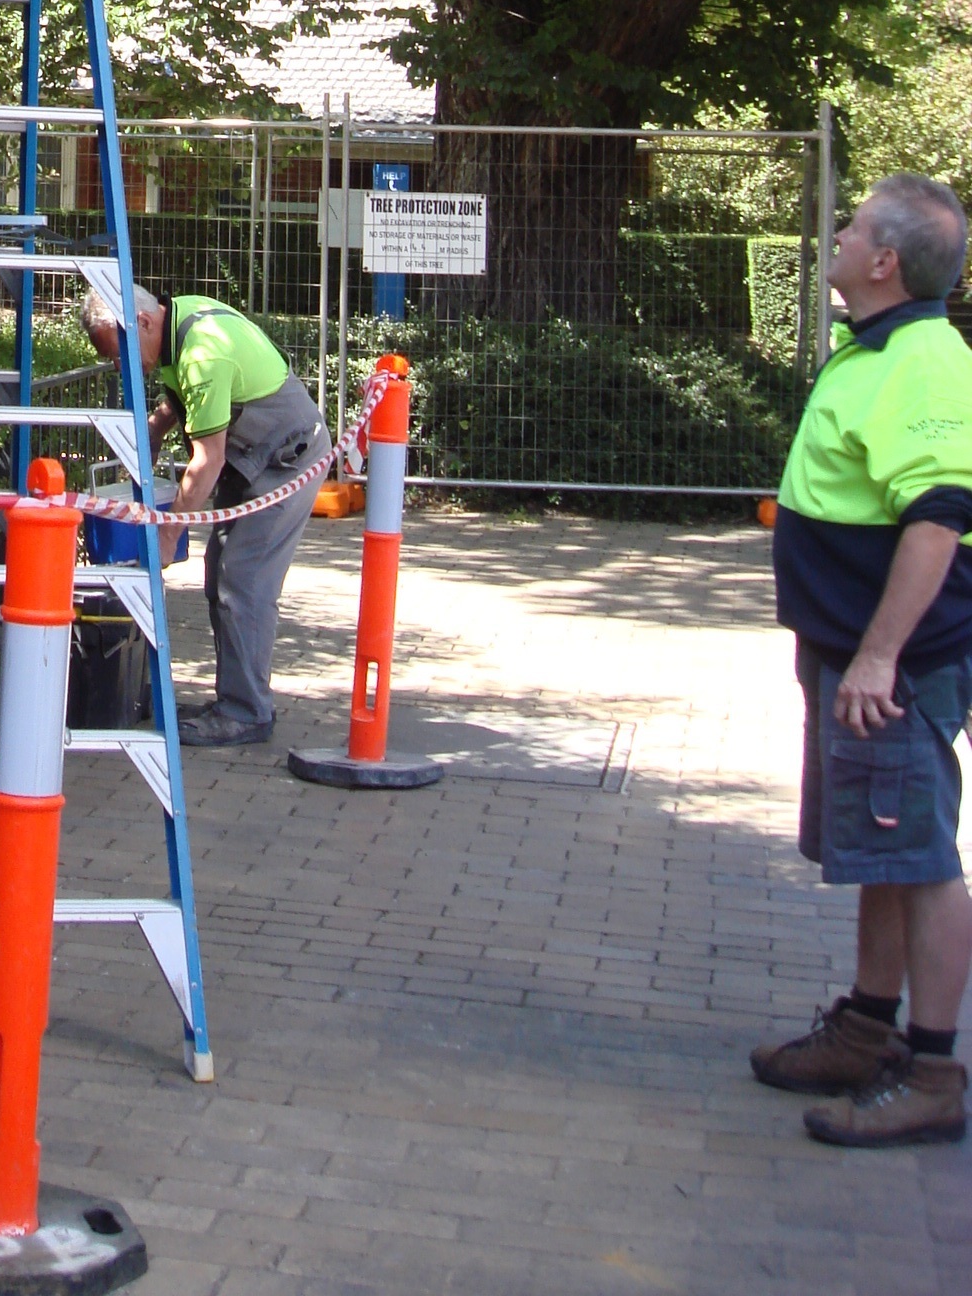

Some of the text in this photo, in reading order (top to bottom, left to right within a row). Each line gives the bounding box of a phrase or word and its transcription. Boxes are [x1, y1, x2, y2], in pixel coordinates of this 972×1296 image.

[382, 172, 406, 180] HELP
[370, 198, 482, 216] TREE PROTECTION ZONE
[379, 231, 406, 239] STORAGE
[417, 233, 449, 241] MATERIALS
[461, 234, 481, 242] WASTE
[429, 261, 444, 269] TREE
